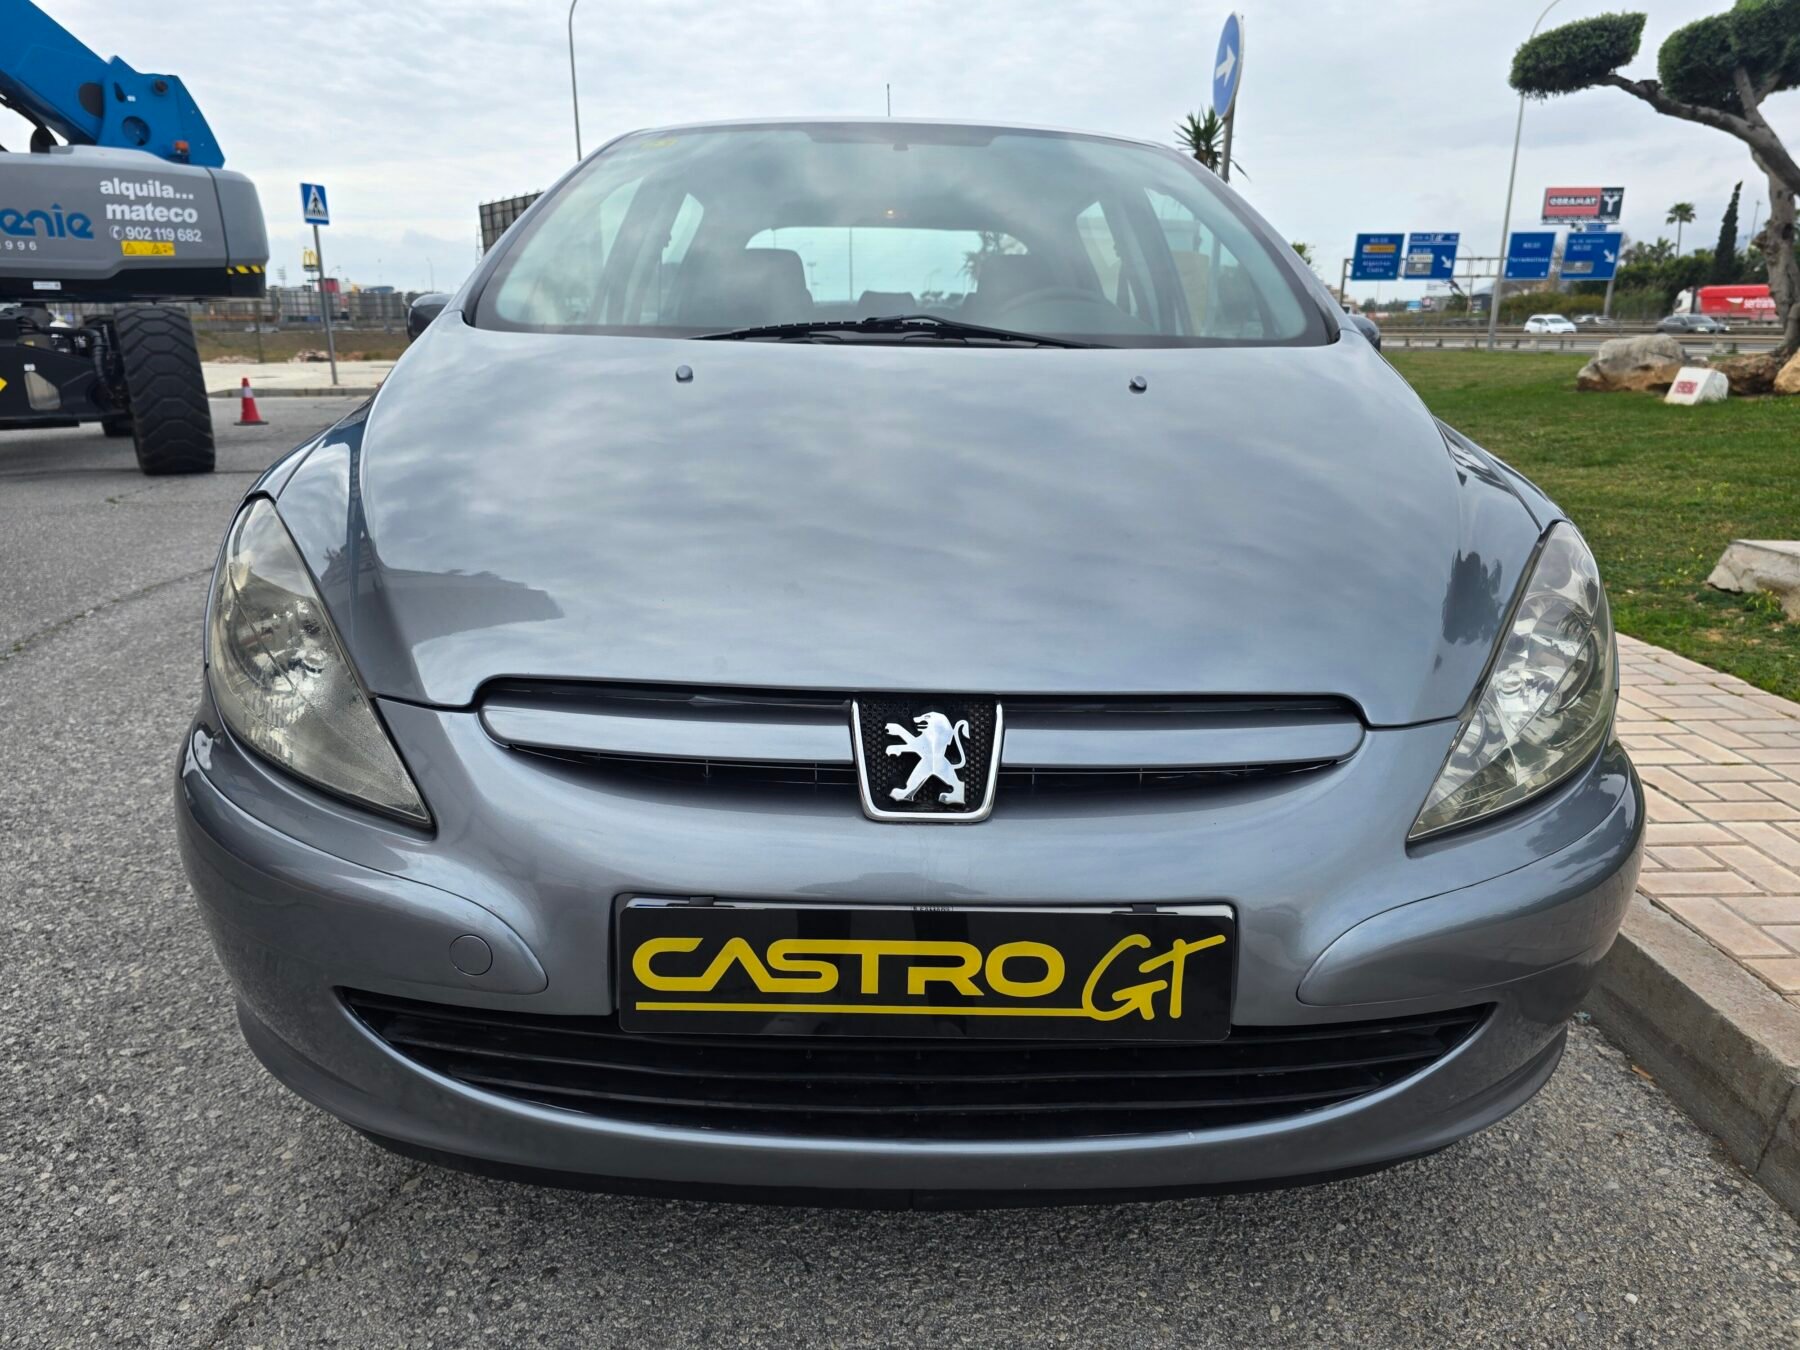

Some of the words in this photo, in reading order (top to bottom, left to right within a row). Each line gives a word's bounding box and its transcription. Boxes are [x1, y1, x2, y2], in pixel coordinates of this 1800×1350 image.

[99, 177, 194, 200] alquila...
[106, 202, 198, 223] mateco
[125, 226, 152, 240] 902
[153, 227, 175, 241] 119
[177, 228, 202, 242] 682
[0, 240, 37, 251] 996
[632, 937, 1065, 998] CASTRO
[1082, 934, 1226, 1021] GT
